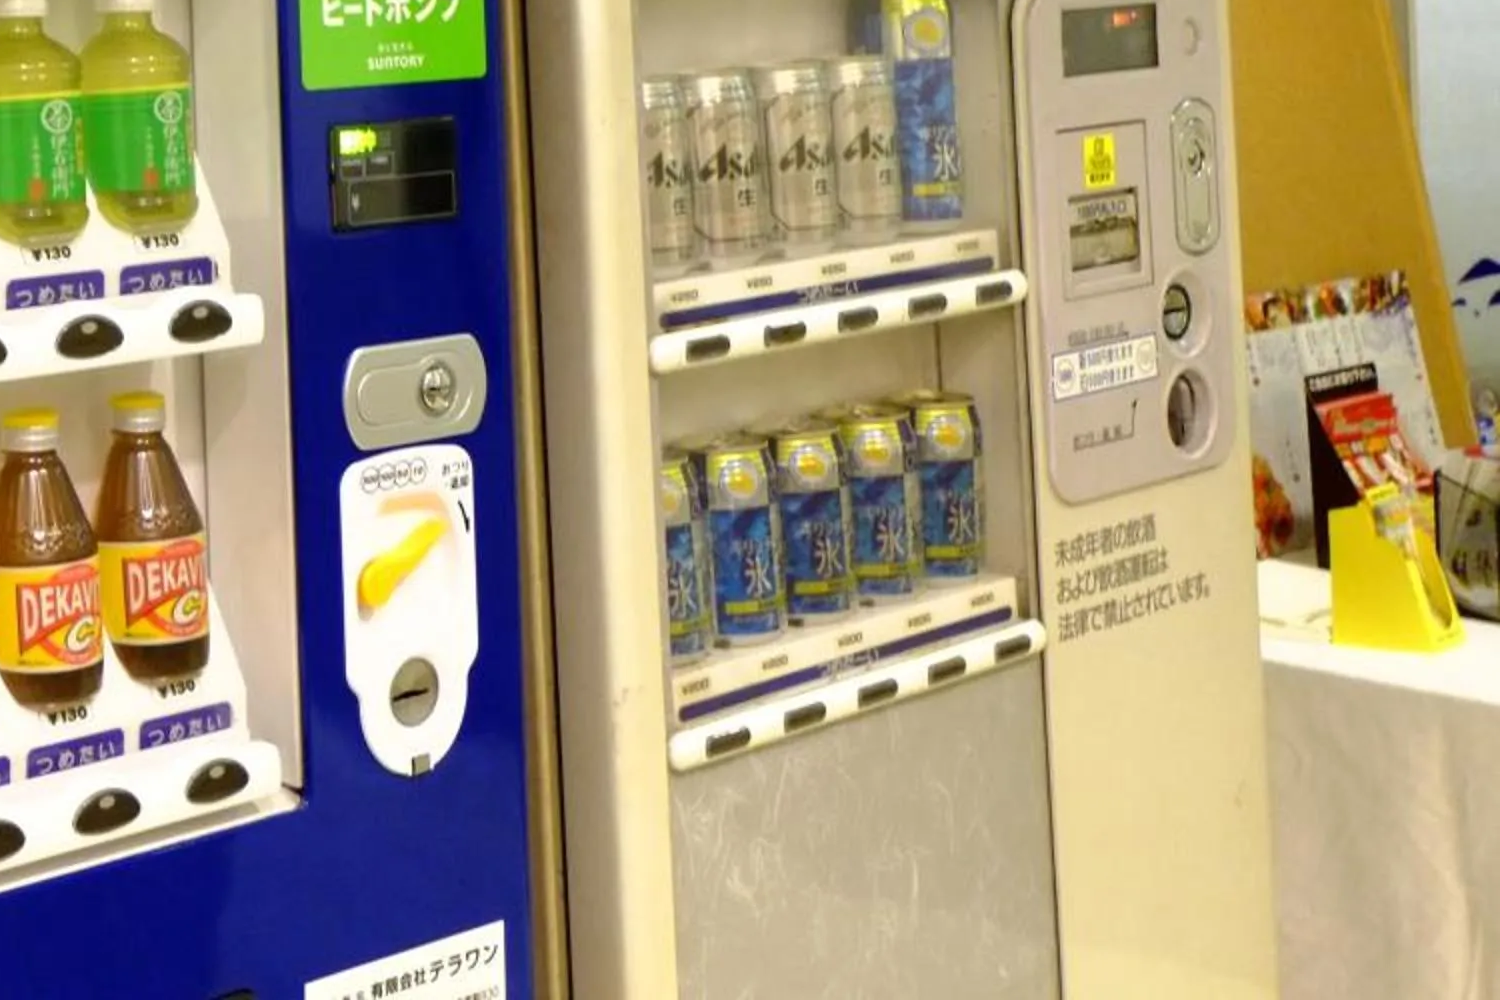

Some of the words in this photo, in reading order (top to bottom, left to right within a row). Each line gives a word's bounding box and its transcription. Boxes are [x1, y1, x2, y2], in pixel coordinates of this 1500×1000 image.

[366, 55, 424, 71] SUNTORY
[31, 245, 73, 263] ¥130
[140, 233, 180, 250] ¥130
[1055, 513, 1156, 568] 未成年者の飲酒
[1056, 545, 1169, 605] および飲酒運転は
[1058, 570, 1211, 643] 法律で禁止されています。
[157, 679, 197, 699] ¥130
[48, 706, 89, 726] ¥130
[147, 713, 224, 746] つめたい
[35, 740, 117, 774] つめたい
[370, 943, 499, 1000] 有限会社テラワン
